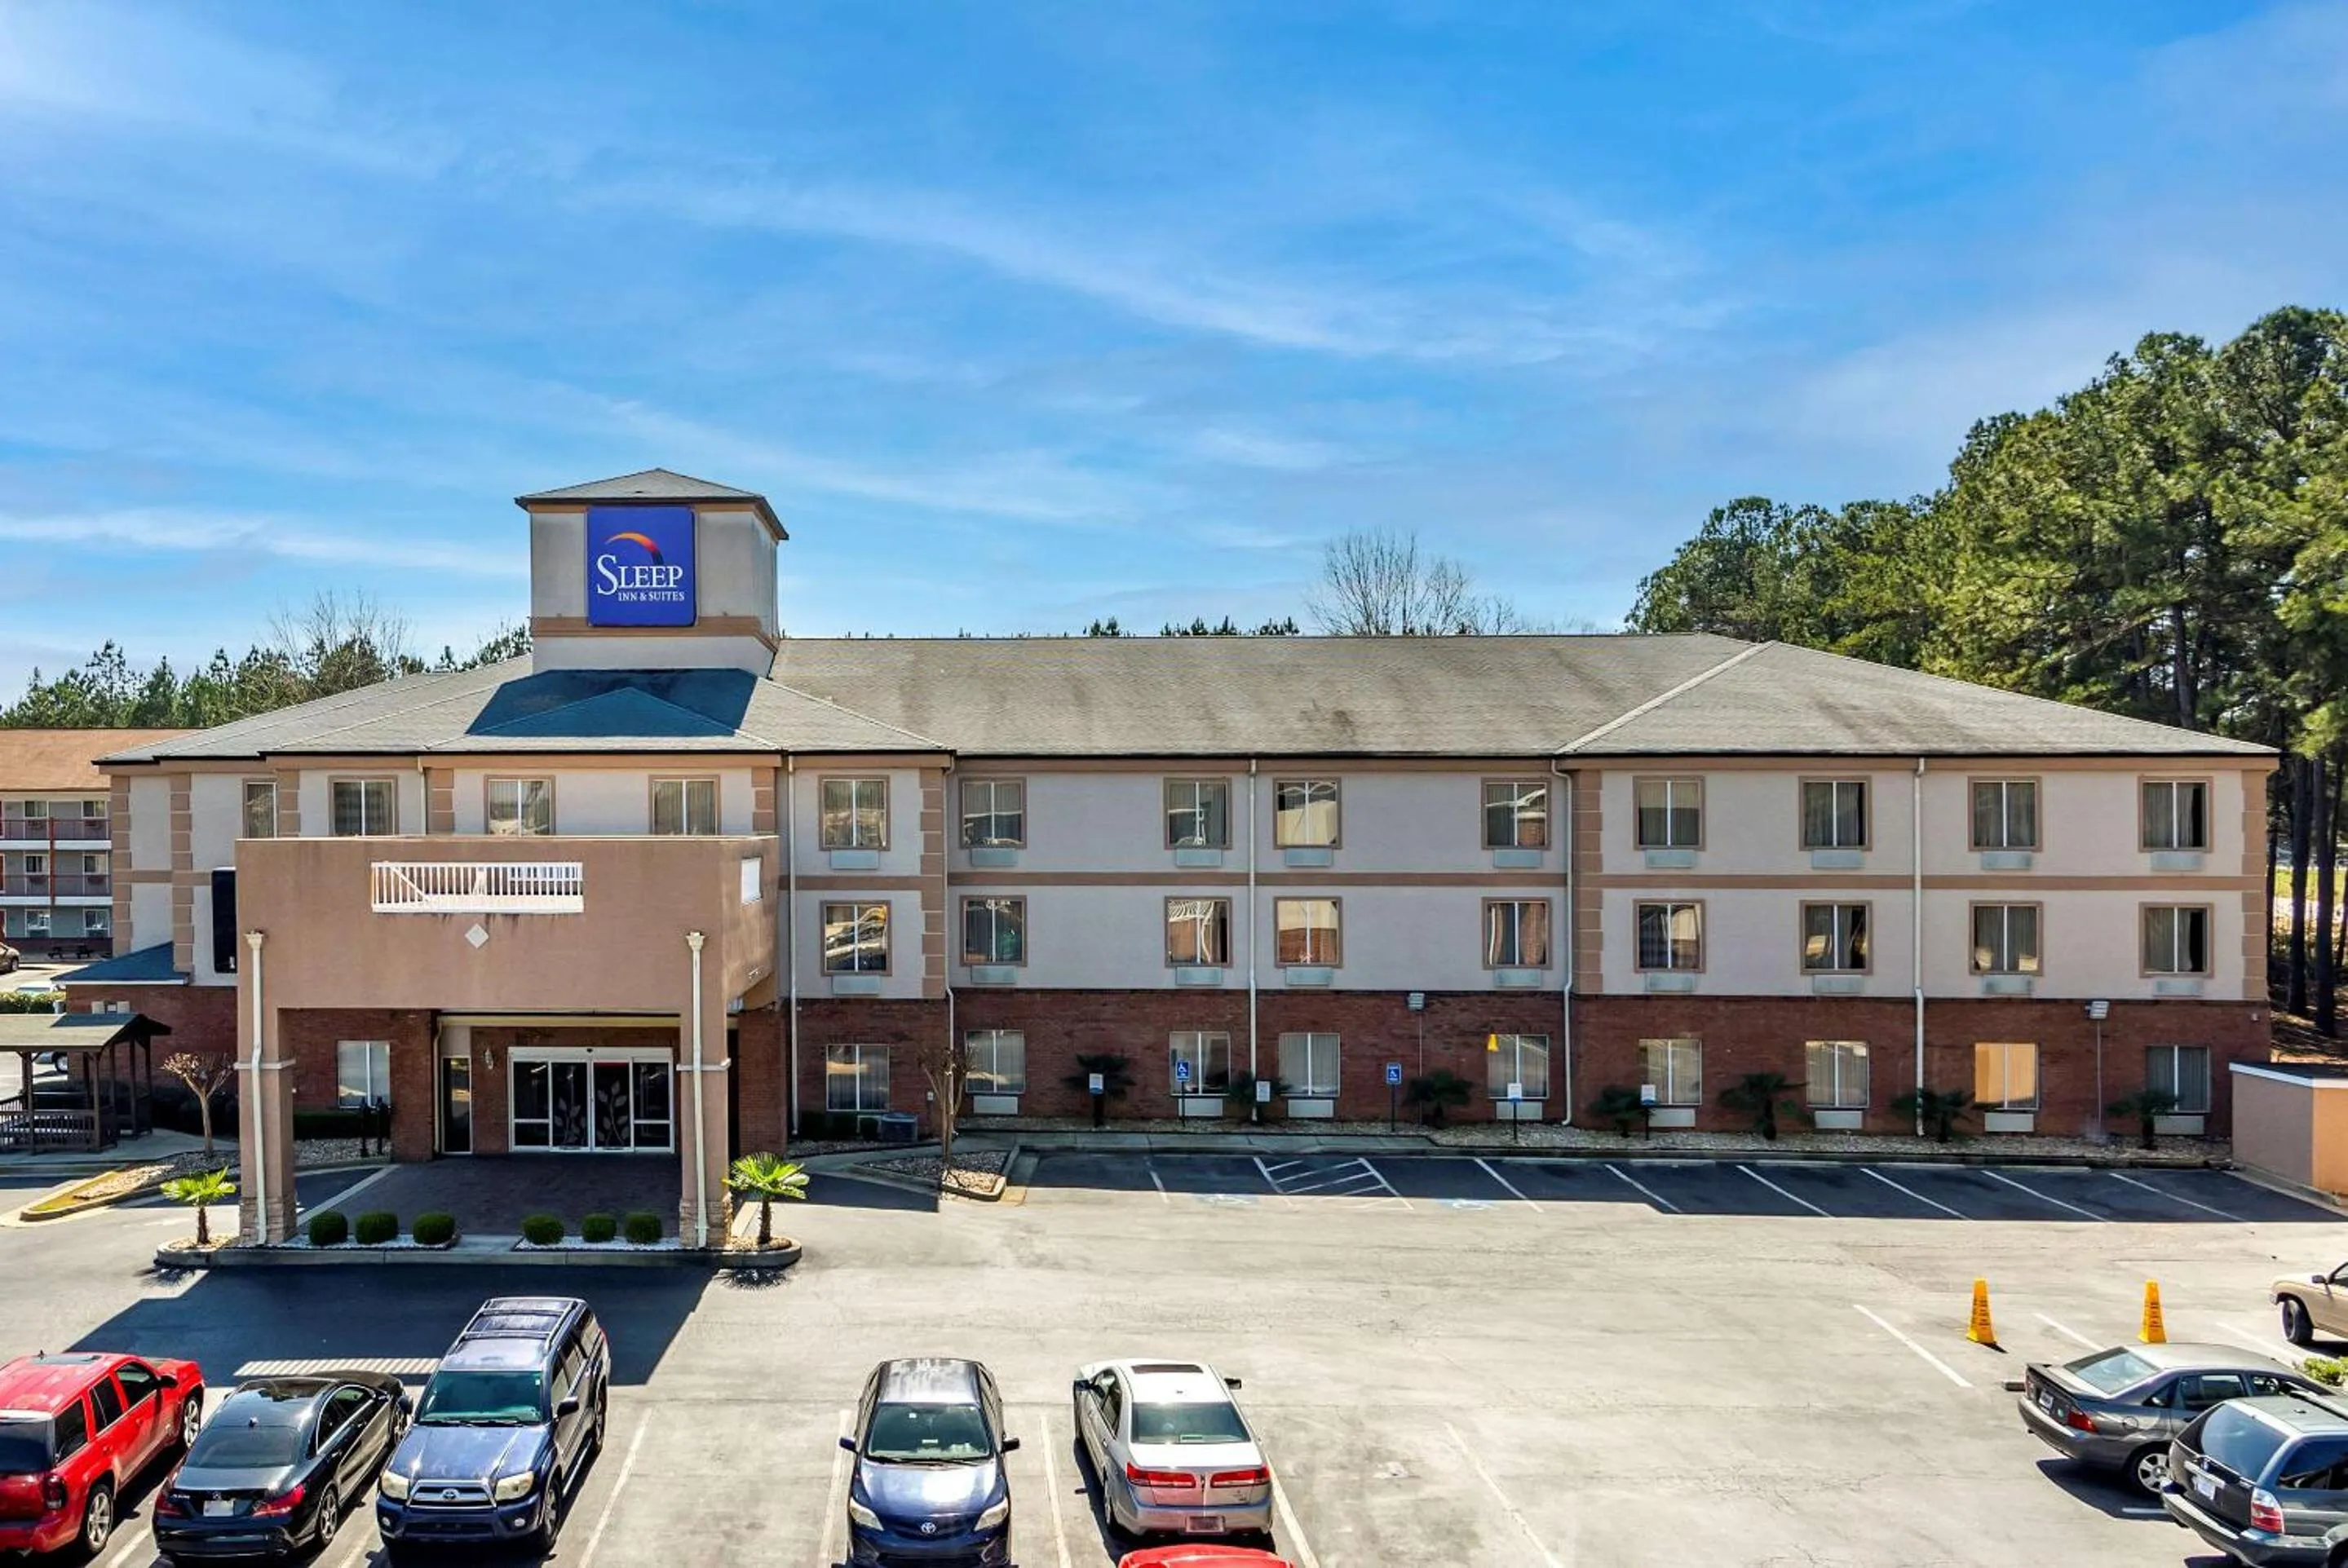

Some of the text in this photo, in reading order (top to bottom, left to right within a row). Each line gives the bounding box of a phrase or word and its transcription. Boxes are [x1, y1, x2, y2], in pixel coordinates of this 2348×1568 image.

[596, 554, 683, 595] SLEEP
[618, 591, 685, 602] INN & SUITES
